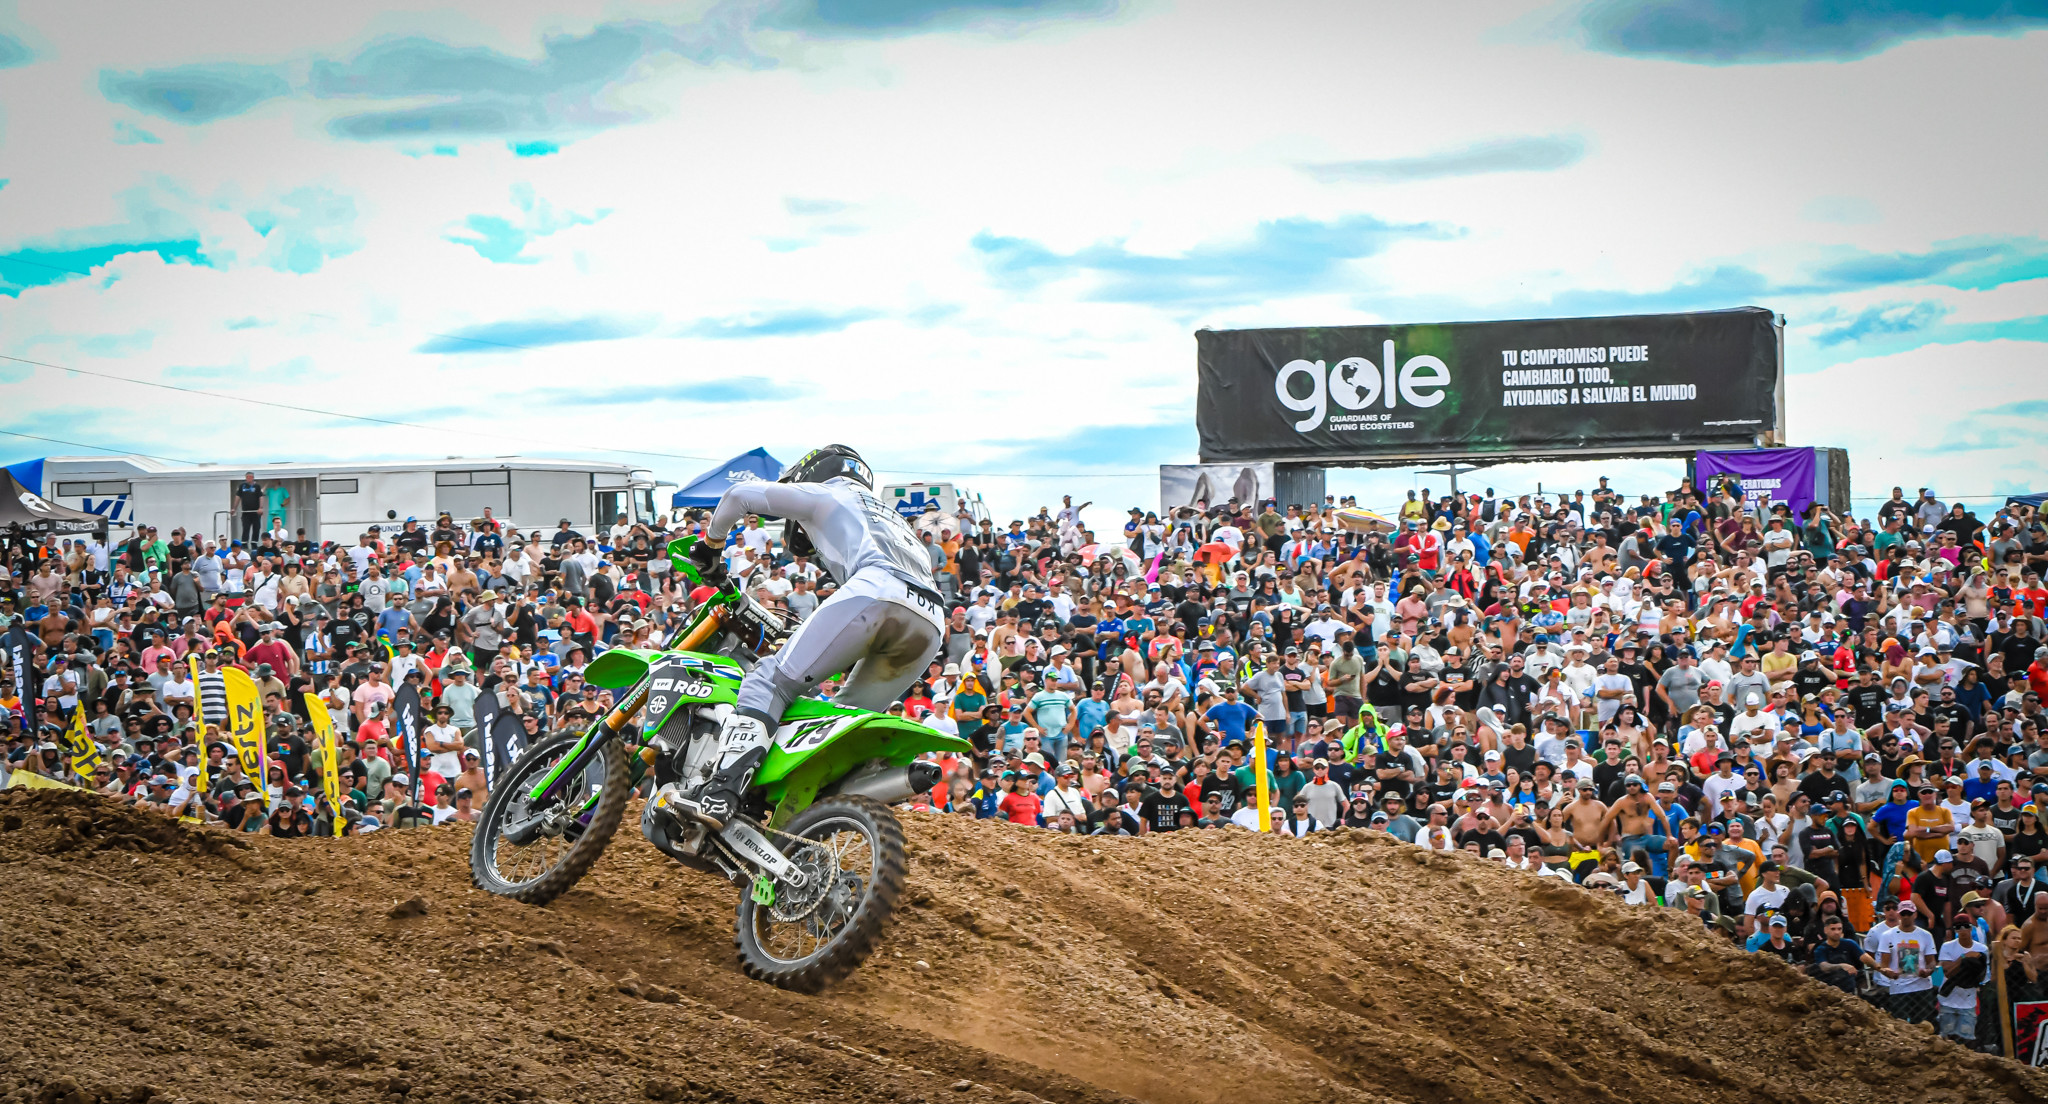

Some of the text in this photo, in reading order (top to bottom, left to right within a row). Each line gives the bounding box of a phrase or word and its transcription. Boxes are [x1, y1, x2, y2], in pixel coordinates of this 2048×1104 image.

[1502, 345, 1648, 366] TU COMPROMISO PUEDE
[1275, 339, 1451, 432] gole
[1502, 367, 1614, 386] CAMBIARLO TODO,
[1503, 383, 1697, 407] AYUDANOS A SALVAR EL MUNDO
[1330, 414, 1392, 423] GUARDIANS OF
[1330, 421, 1415, 432] LIVING ECOSYSTEMS
[906, 586, 936, 615] FOX
[673, 680, 713, 698] RÖD
[732, 732, 758, 742] FOX
[784, 720, 836, 749] 179
[744, 838, 778, 865] DUNLOP
